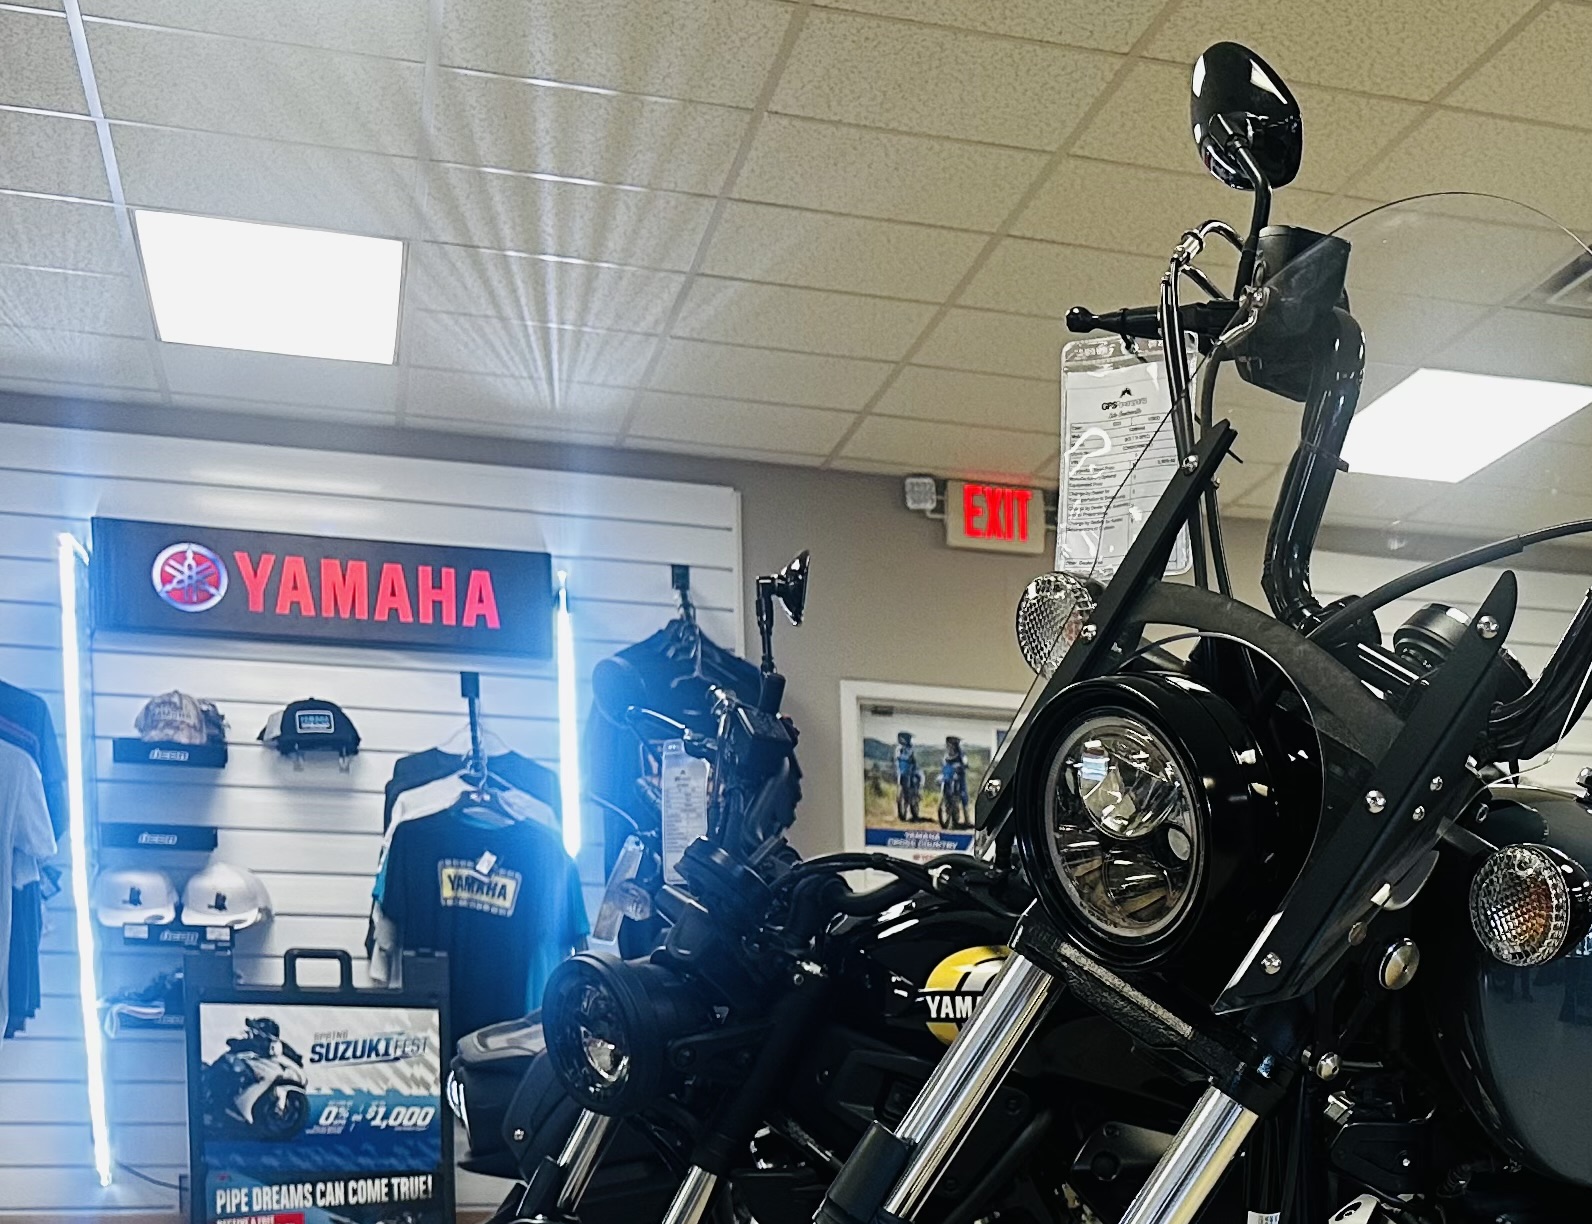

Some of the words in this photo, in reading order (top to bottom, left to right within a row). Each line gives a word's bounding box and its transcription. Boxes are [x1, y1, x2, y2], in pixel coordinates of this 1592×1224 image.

[963, 484, 1032, 543] EXIT
[234, 551, 500, 629] YAMAHA
[447, 873, 508, 902] YAMAHA
[925, 995, 985, 1018] YAM
[216, 1189, 249, 1214] PIPE
[252, 1183, 313, 1211] DREAMS
[316, 1180, 345, 1207] CAN
[348, 1177, 389, 1205] COME
[391, 1174, 433, 1200] TRUE!
